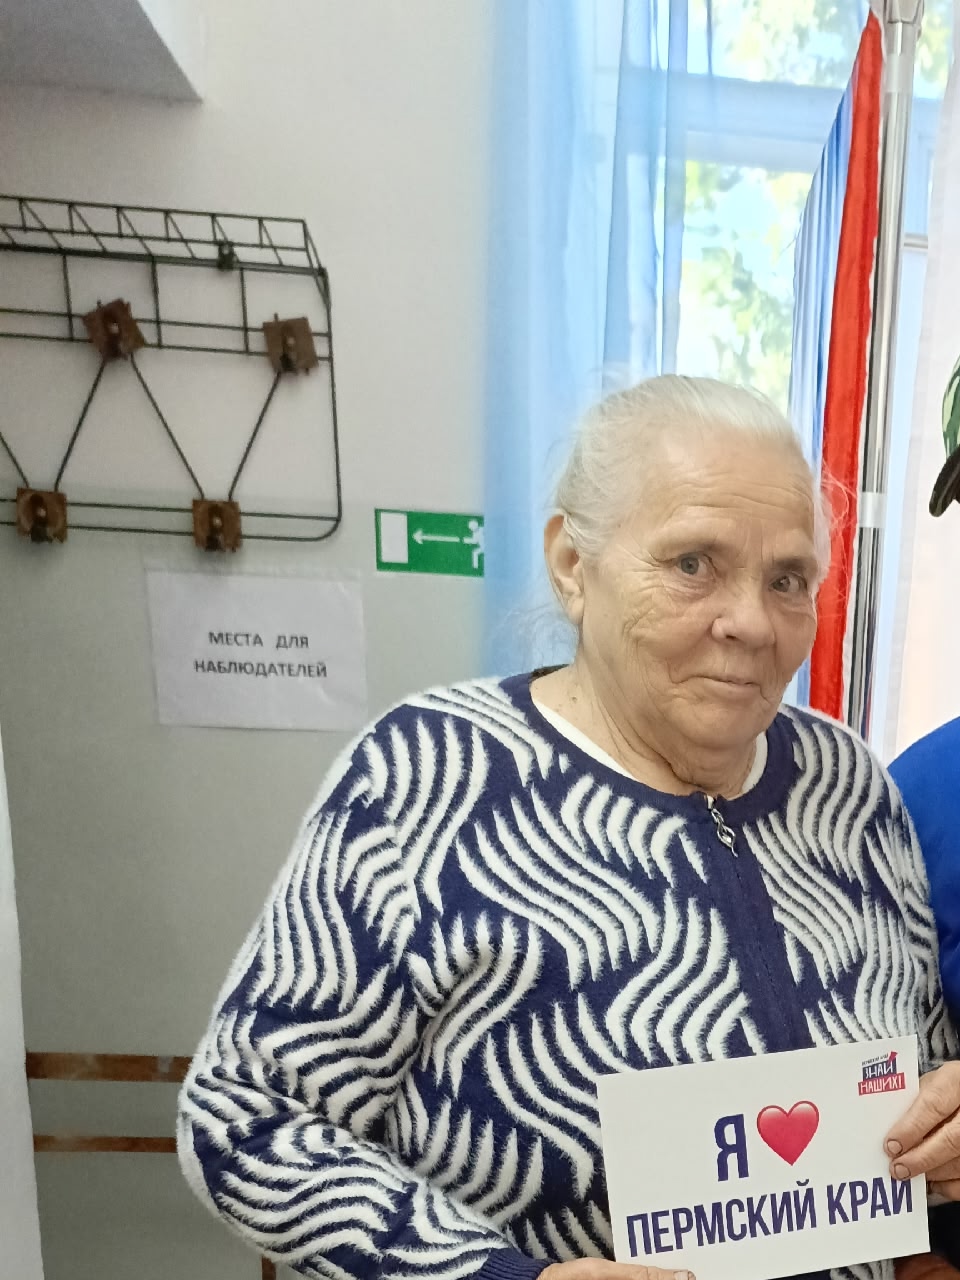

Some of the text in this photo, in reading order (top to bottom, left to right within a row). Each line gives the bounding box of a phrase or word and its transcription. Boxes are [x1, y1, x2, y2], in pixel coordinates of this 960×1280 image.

[208, 631, 309, 650] МЕСТА ДЛЯ
[194, 659, 327, 678] НАБЛЮДАТЕЛЕЙ
[714, 1114, 749, 1182] Я
[626, 1177, 913, 1258] ПЕРМСКИЙ КРАЙ
